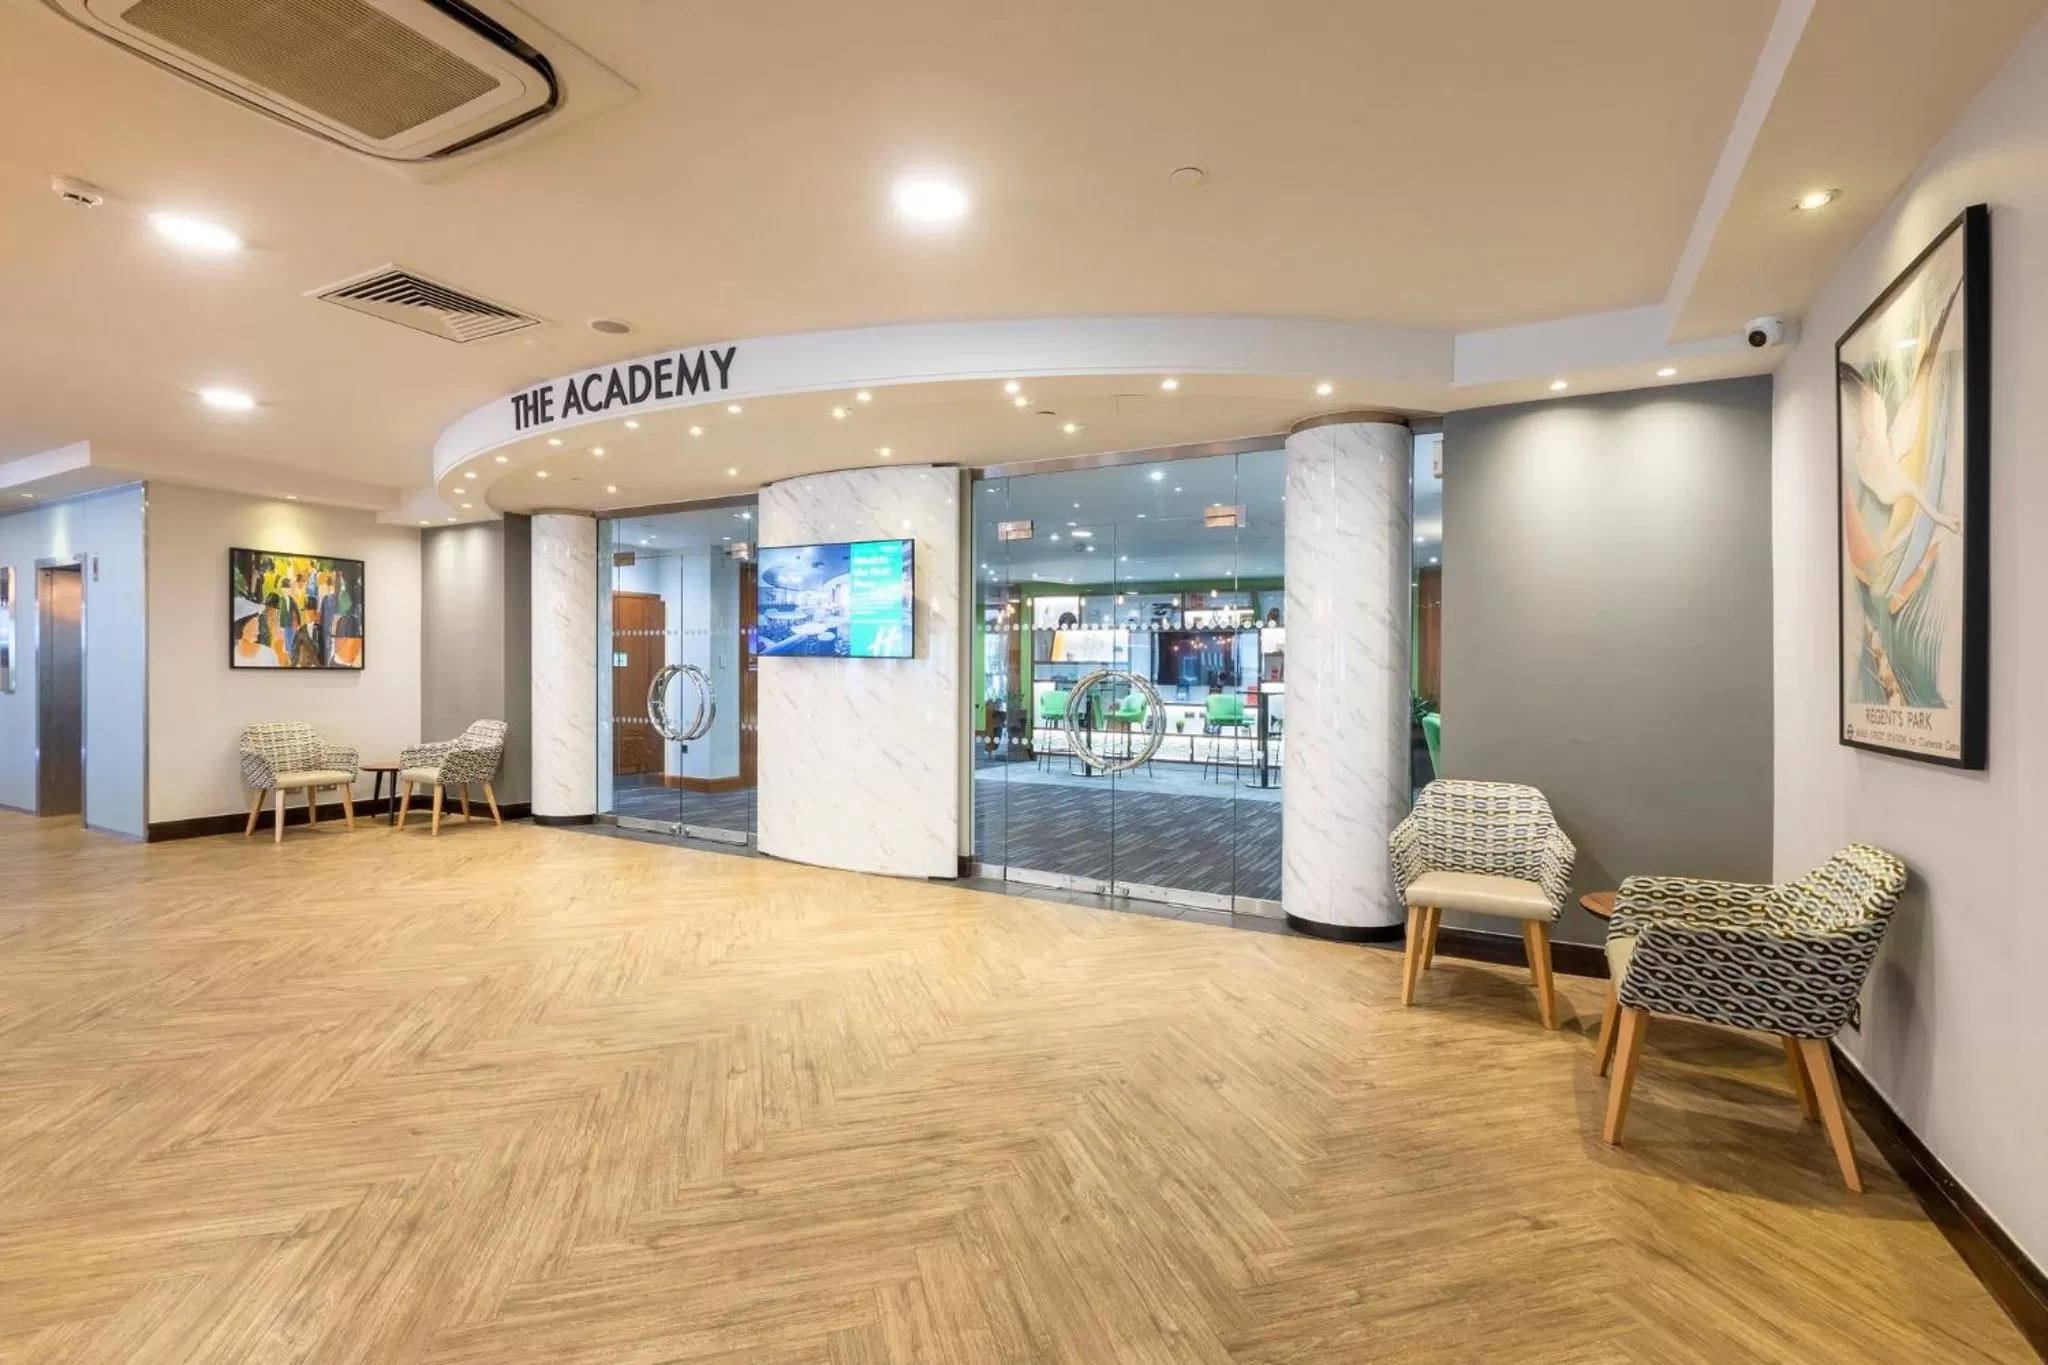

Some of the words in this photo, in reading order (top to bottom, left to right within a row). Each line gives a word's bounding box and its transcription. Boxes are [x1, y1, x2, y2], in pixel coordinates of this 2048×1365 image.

[511, 386, 554, 430] THE
[561, 346, 736, 418] ACADEMY
[1907, 711, 1933, 730] PARK
